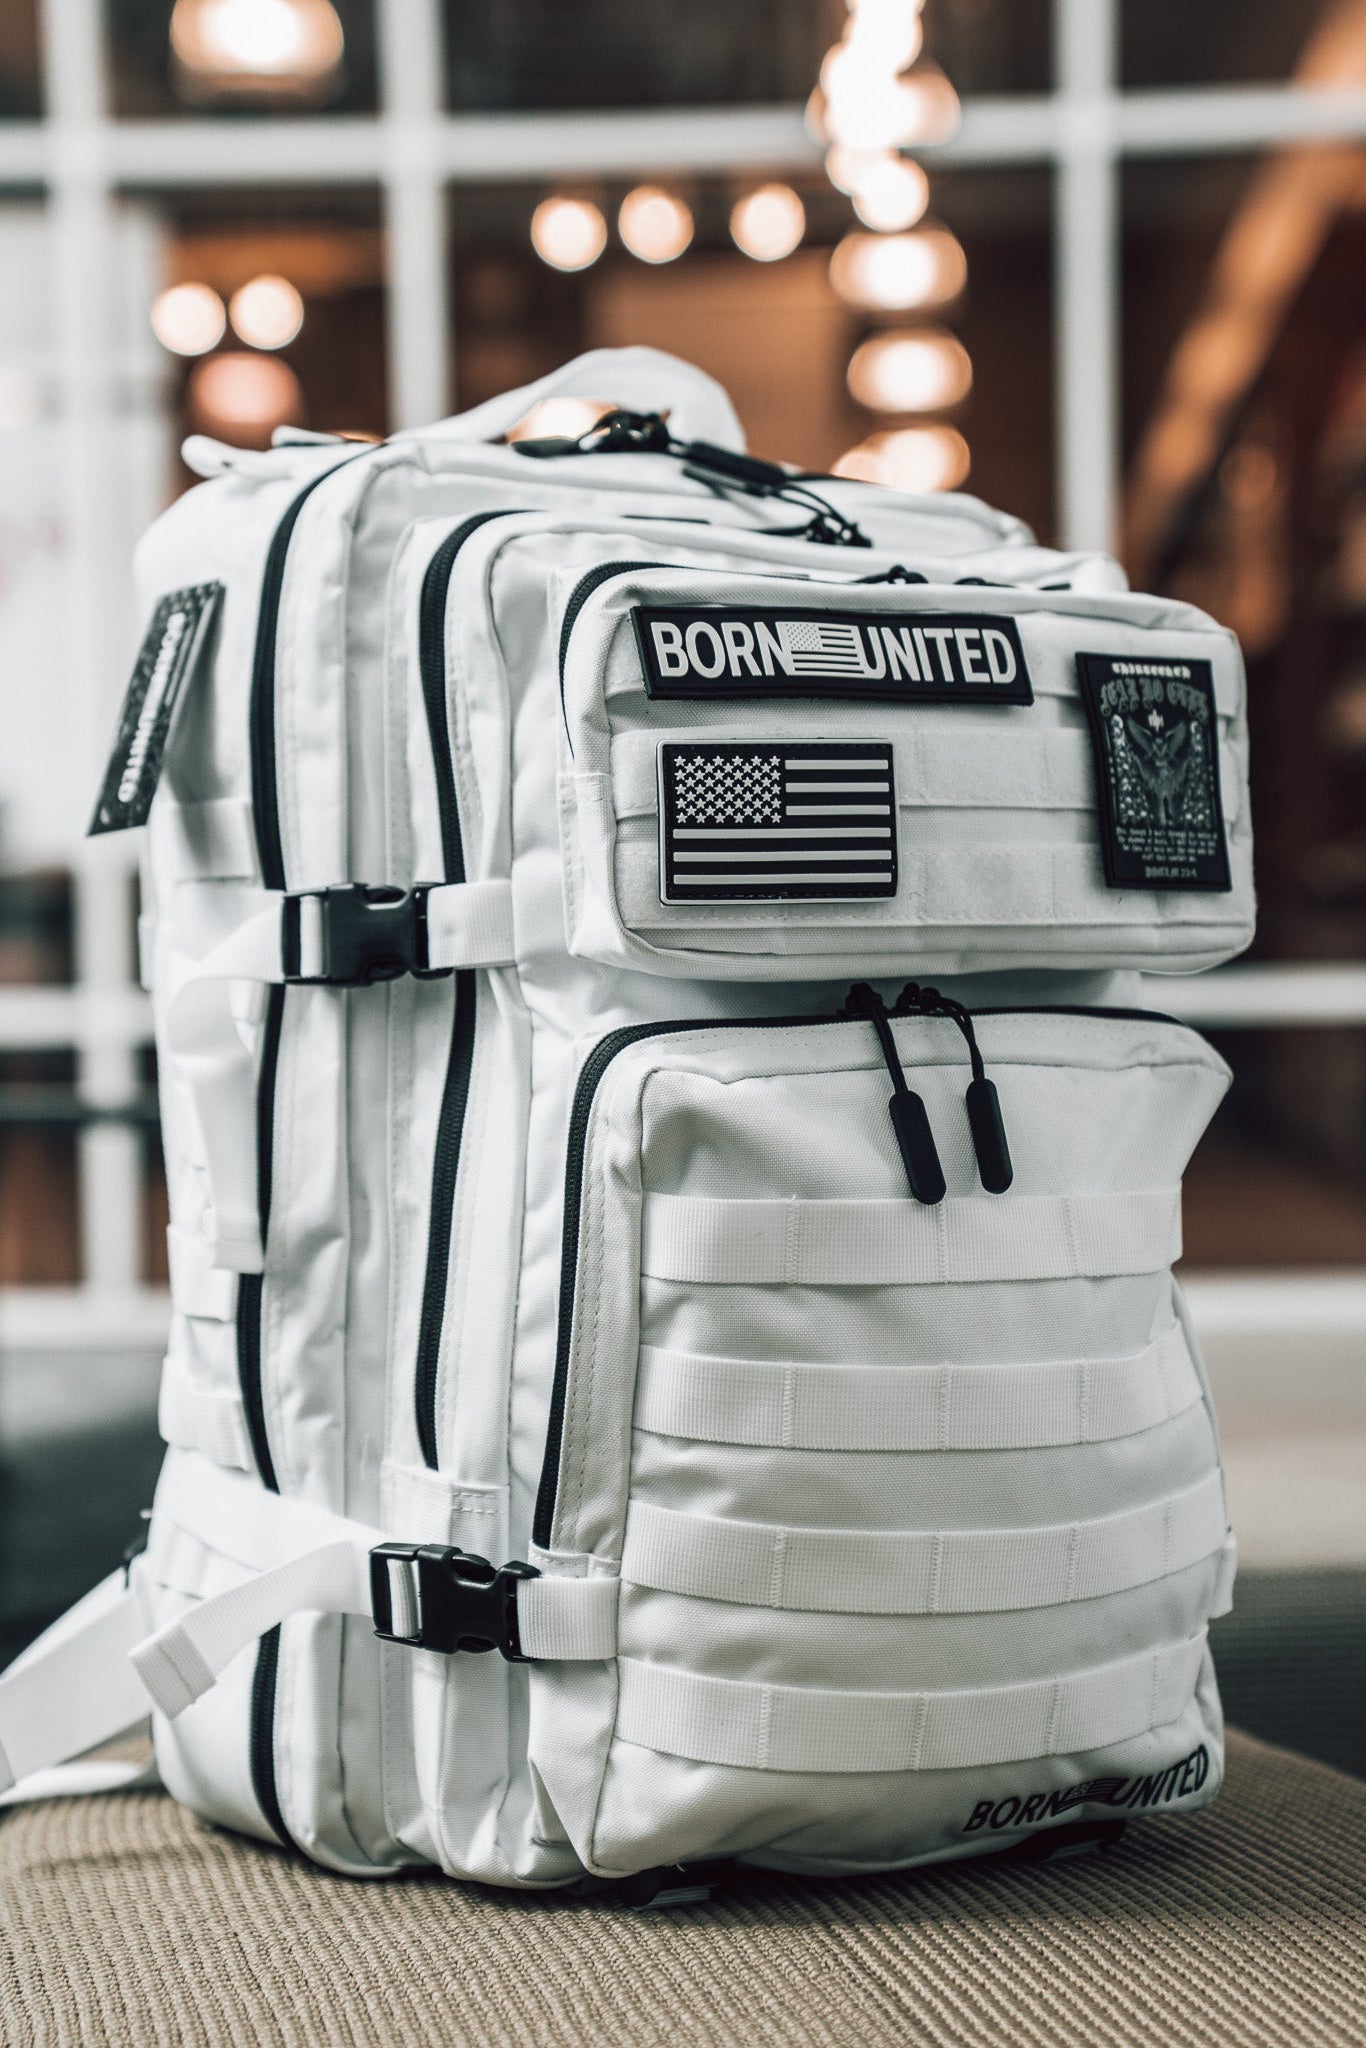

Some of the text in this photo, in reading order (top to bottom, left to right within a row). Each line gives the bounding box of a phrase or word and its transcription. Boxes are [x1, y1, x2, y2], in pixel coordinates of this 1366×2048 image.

[650, 621, 1018, 684] BORN UNITED
[963, 1744, 1209, 1832] BORN UNITED
